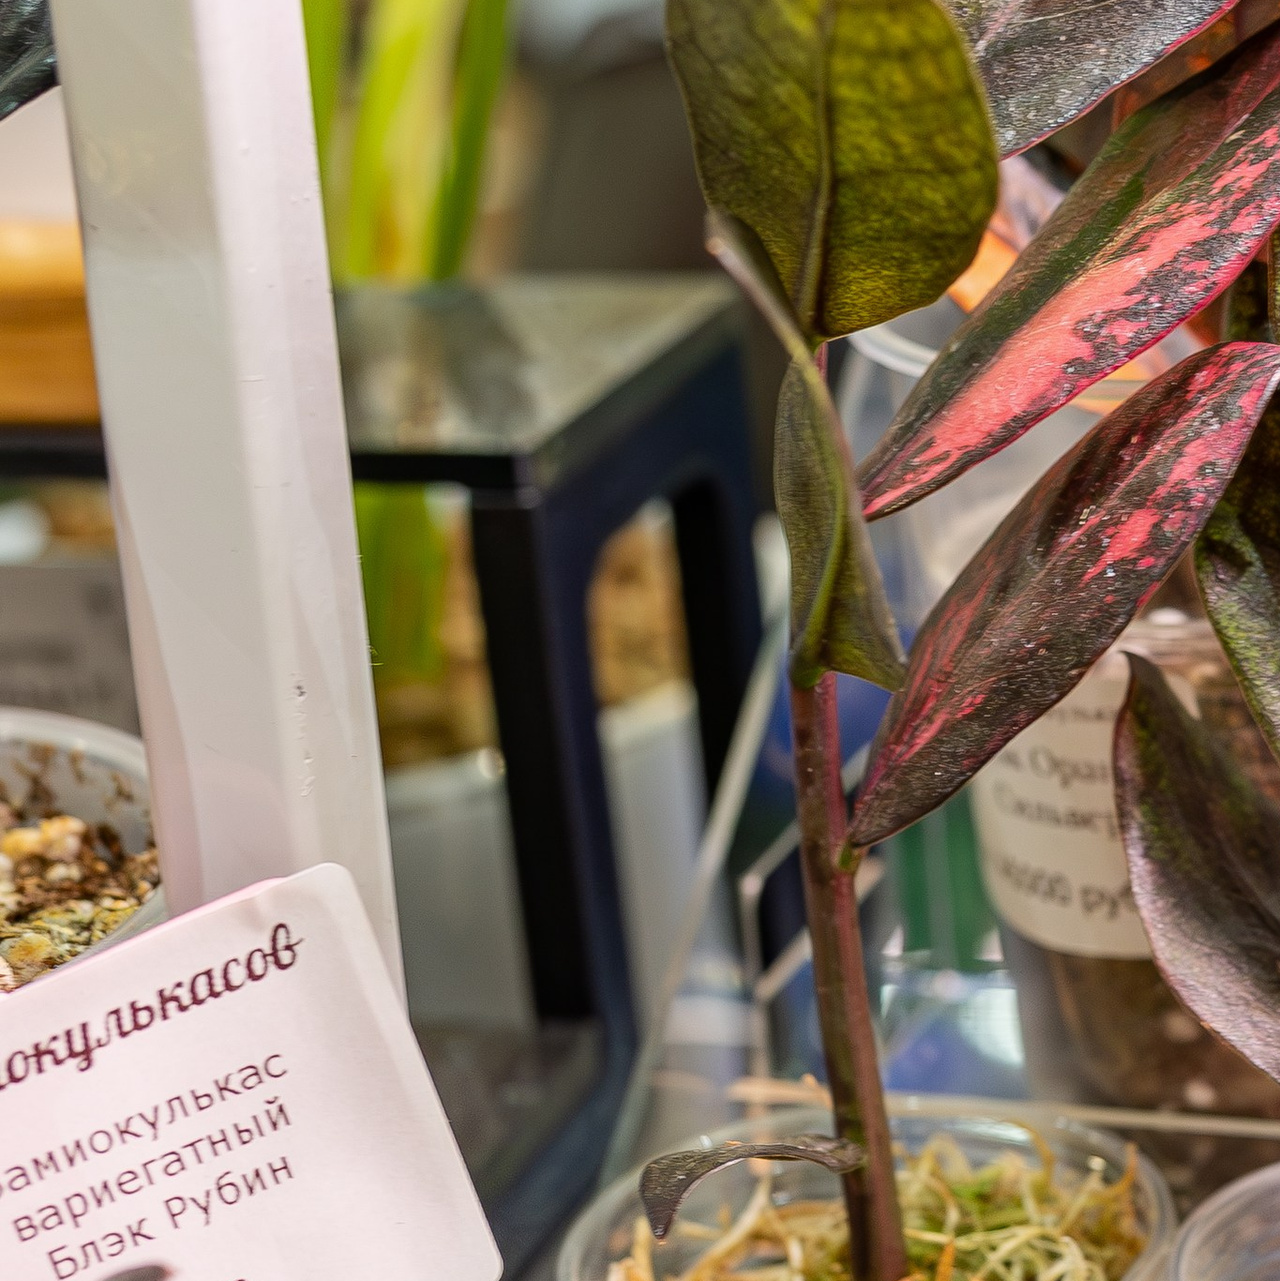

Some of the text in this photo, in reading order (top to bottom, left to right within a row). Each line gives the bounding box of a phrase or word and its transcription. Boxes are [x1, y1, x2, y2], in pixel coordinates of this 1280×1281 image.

[13, 1095, 293, 1243] вариегатный
[47, 1156, 295, 1281] Блэк Рубин
